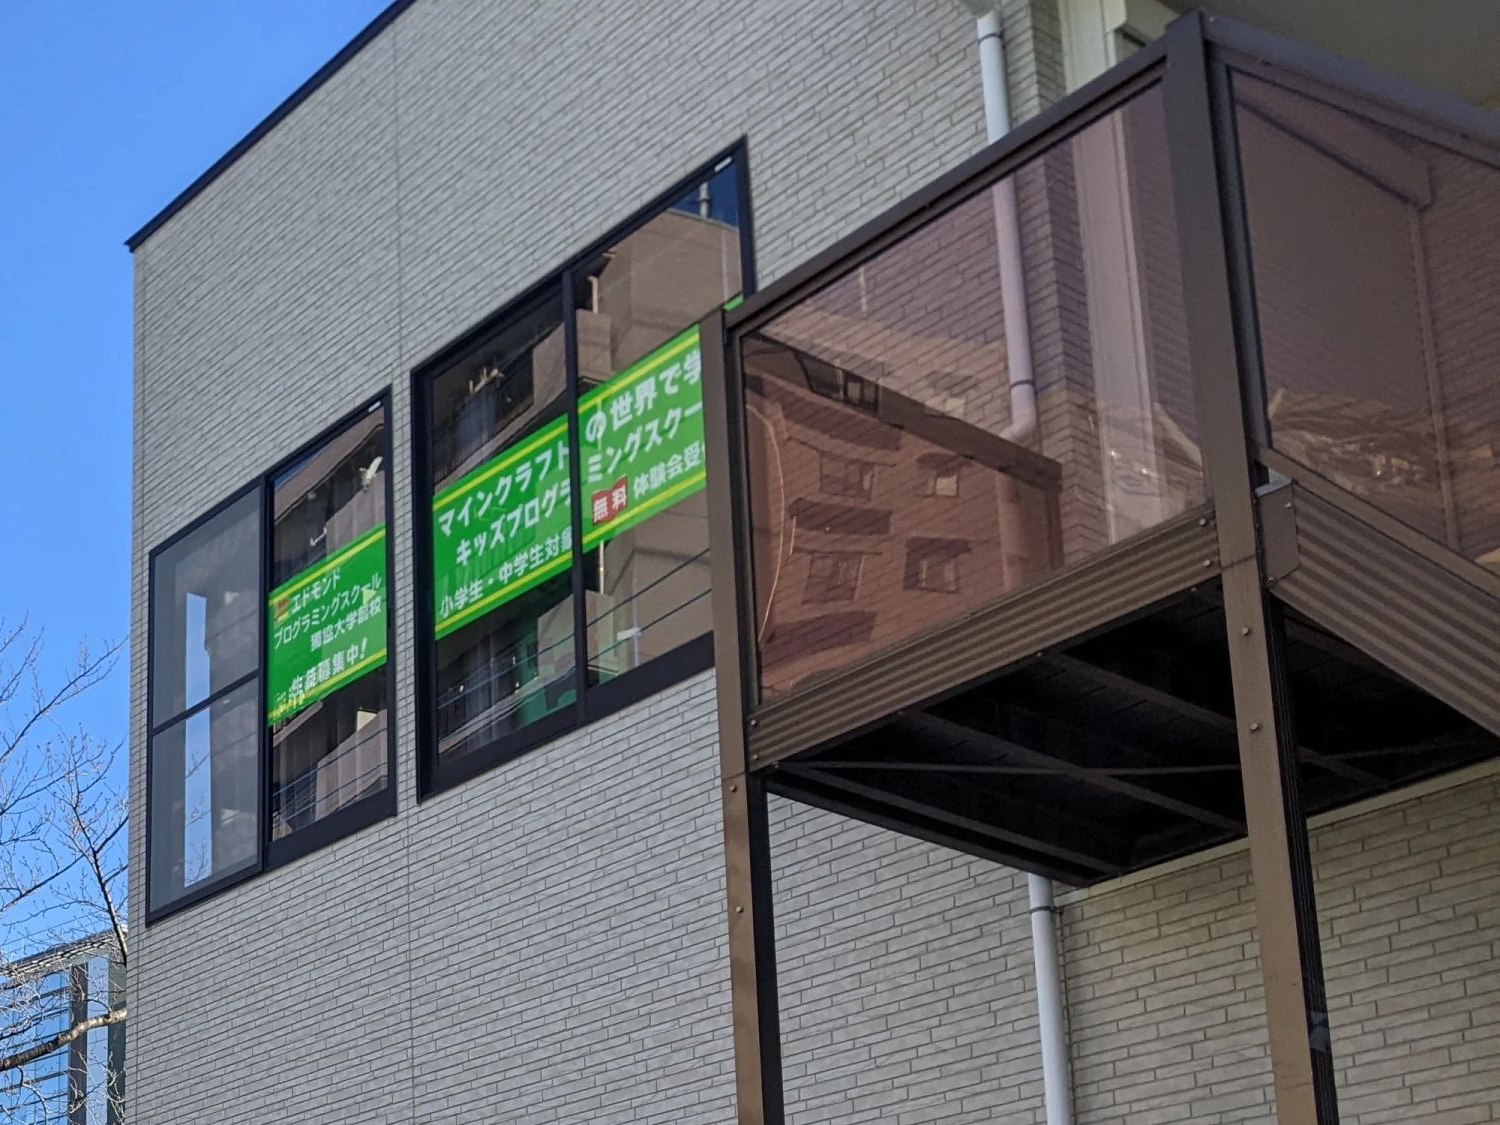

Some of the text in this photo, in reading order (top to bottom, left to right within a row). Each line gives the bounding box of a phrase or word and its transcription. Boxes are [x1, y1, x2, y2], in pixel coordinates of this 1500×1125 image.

[438, 348, 701, 537] マインクラフト の世界で学
[587, 401, 703, 483] ミングスクー
[593, 484, 627, 523] 無料
[632, 440, 705, 499] 体験会受
[274, 572, 382, 650] プログラミングスクール
[291, 567, 340, 613] エドモンド
